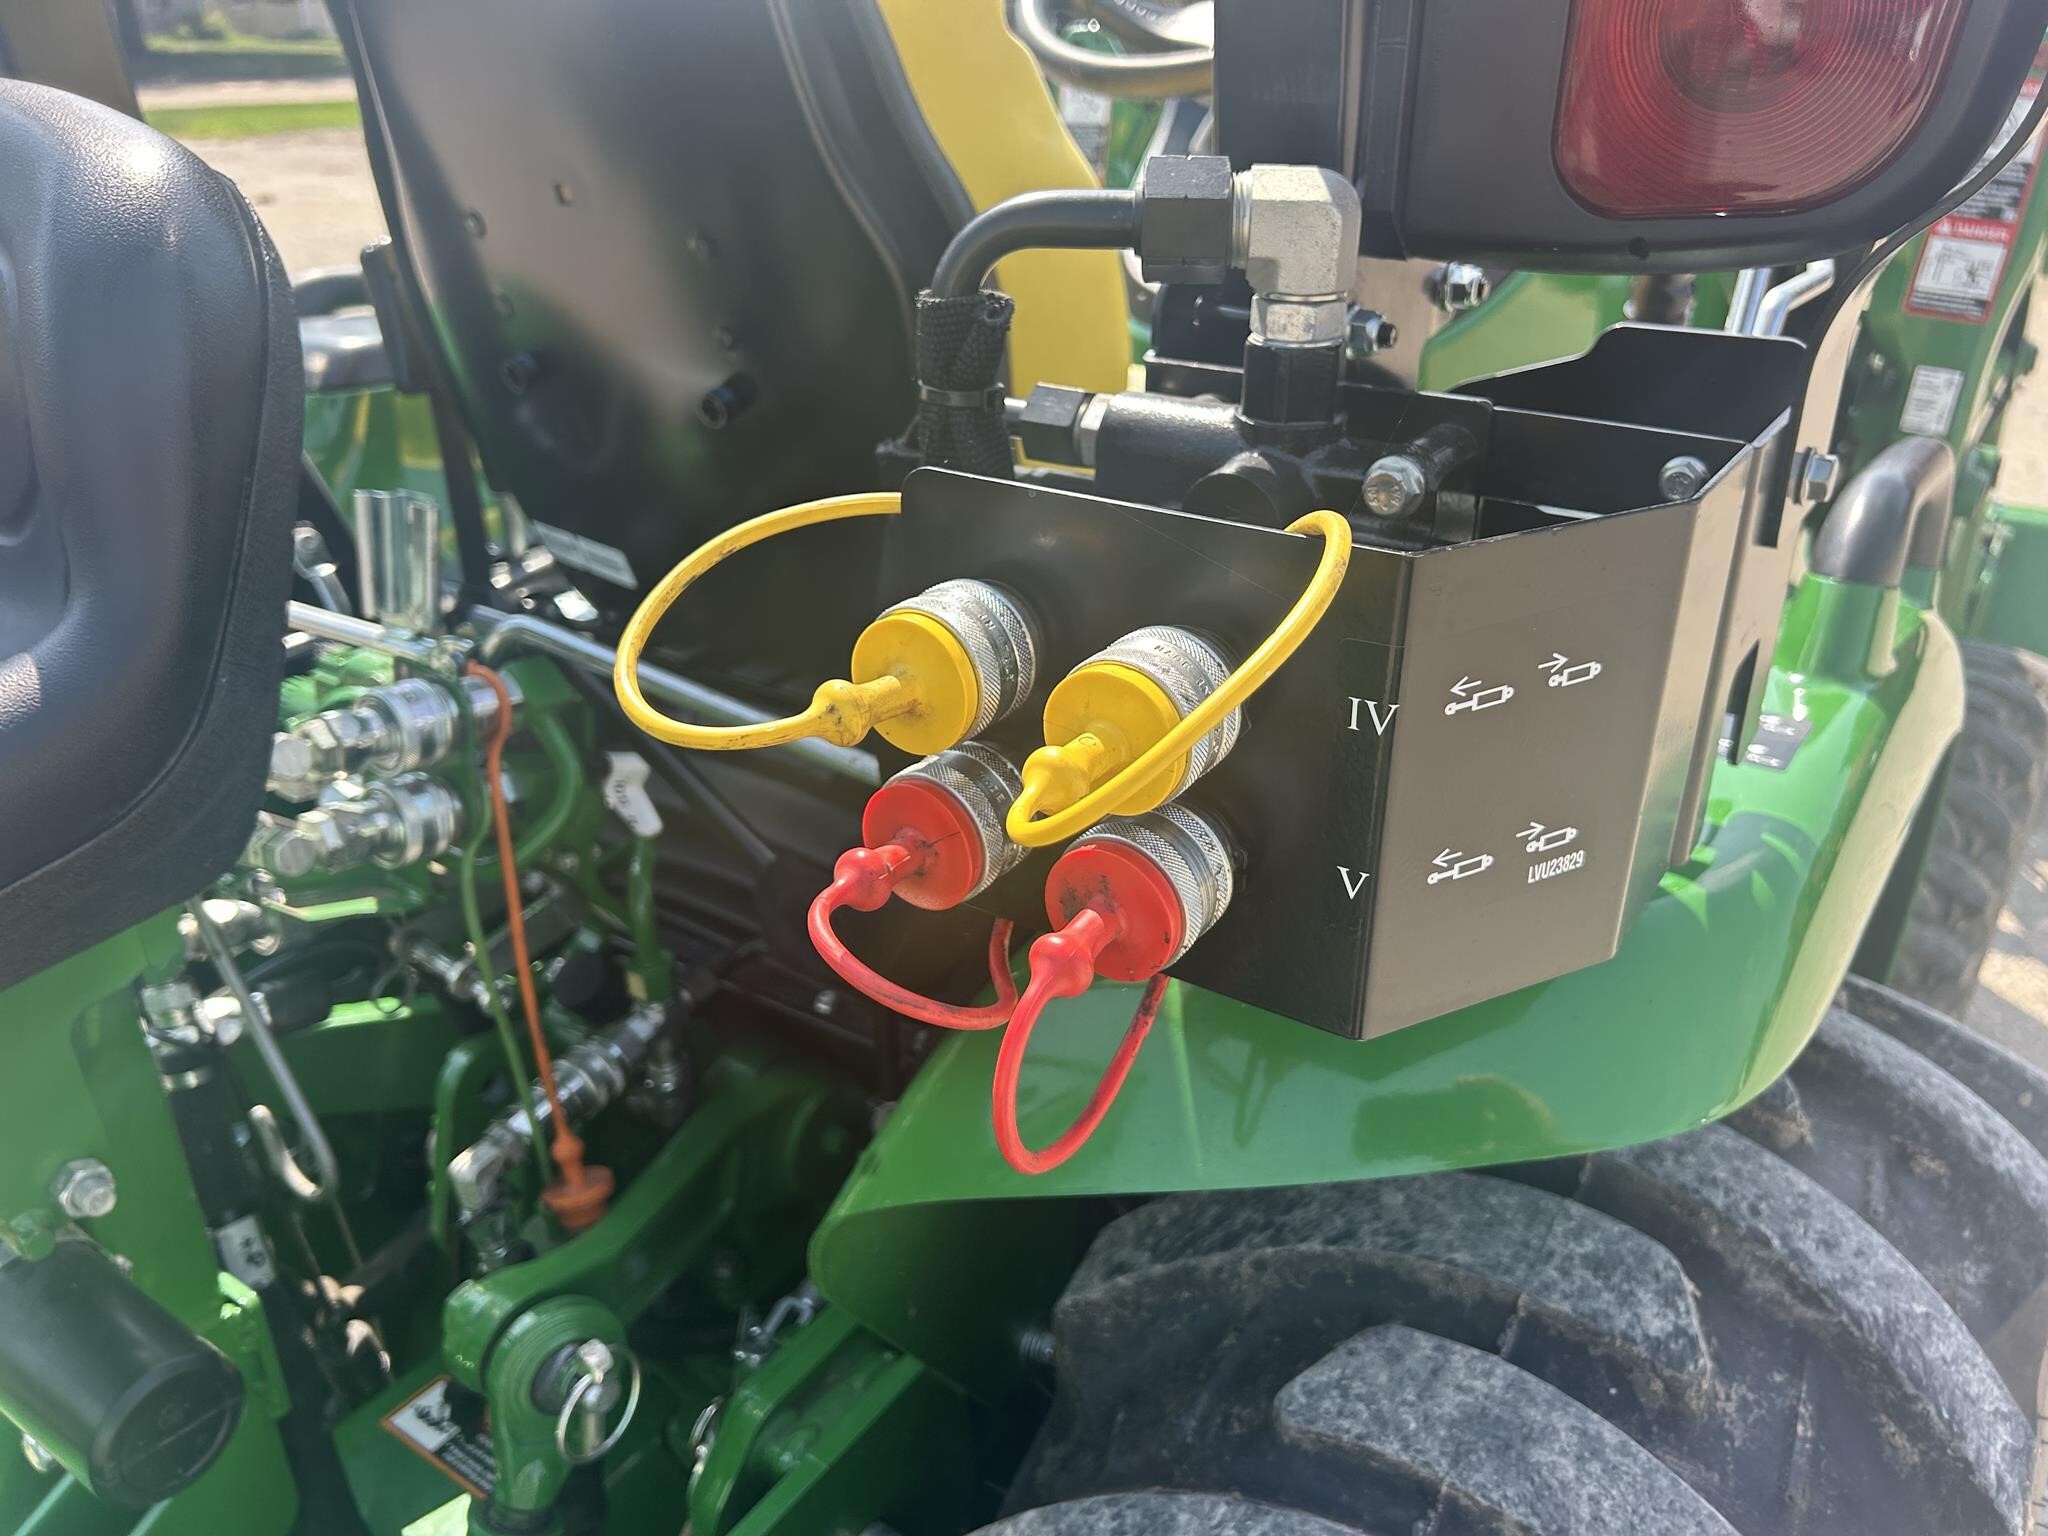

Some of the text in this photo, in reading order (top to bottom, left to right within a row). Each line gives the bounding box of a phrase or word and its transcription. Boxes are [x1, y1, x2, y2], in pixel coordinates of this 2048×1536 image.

[1347, 696, 1400, 736] IV
[1336, 865, 1370, 900] V
[1527, 849, 1586, 884] LVU23829
